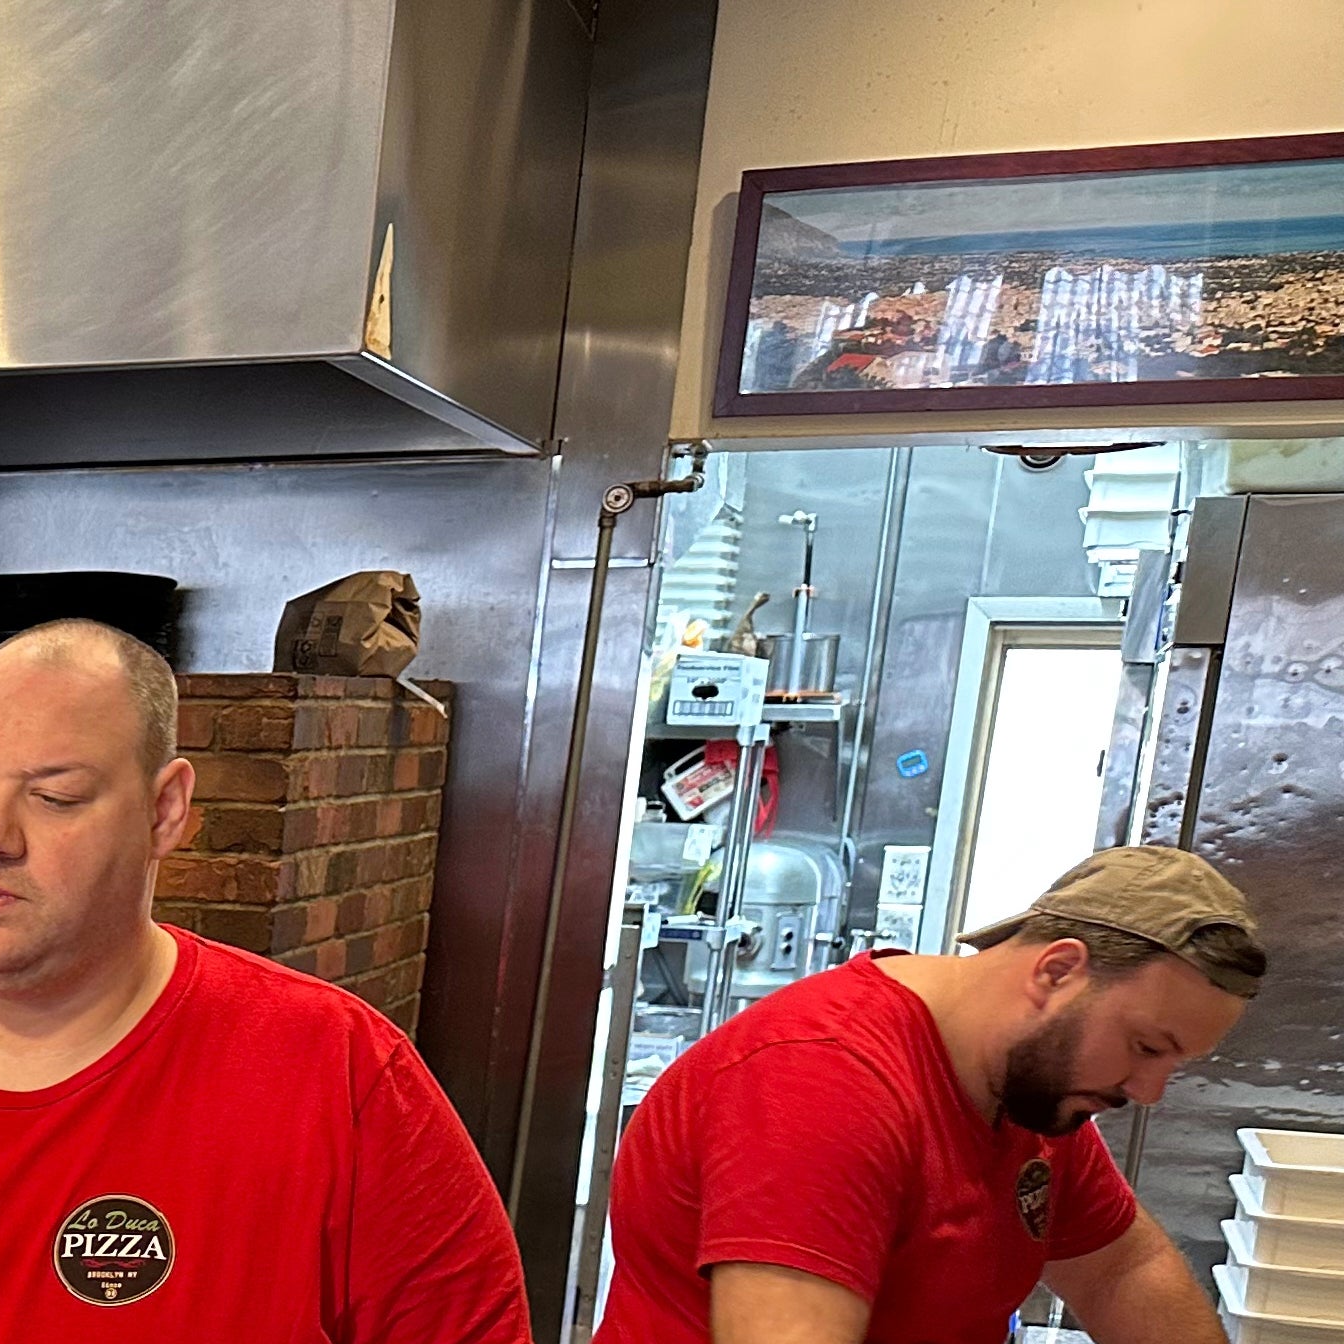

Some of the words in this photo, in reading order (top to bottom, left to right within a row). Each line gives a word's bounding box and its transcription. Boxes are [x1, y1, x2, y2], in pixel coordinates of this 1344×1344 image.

[68, 1210, 98, 1230] Lo
[106, 1211, 160, 1231] Duca
[61, 1234, 166, 1260] PIZZA
